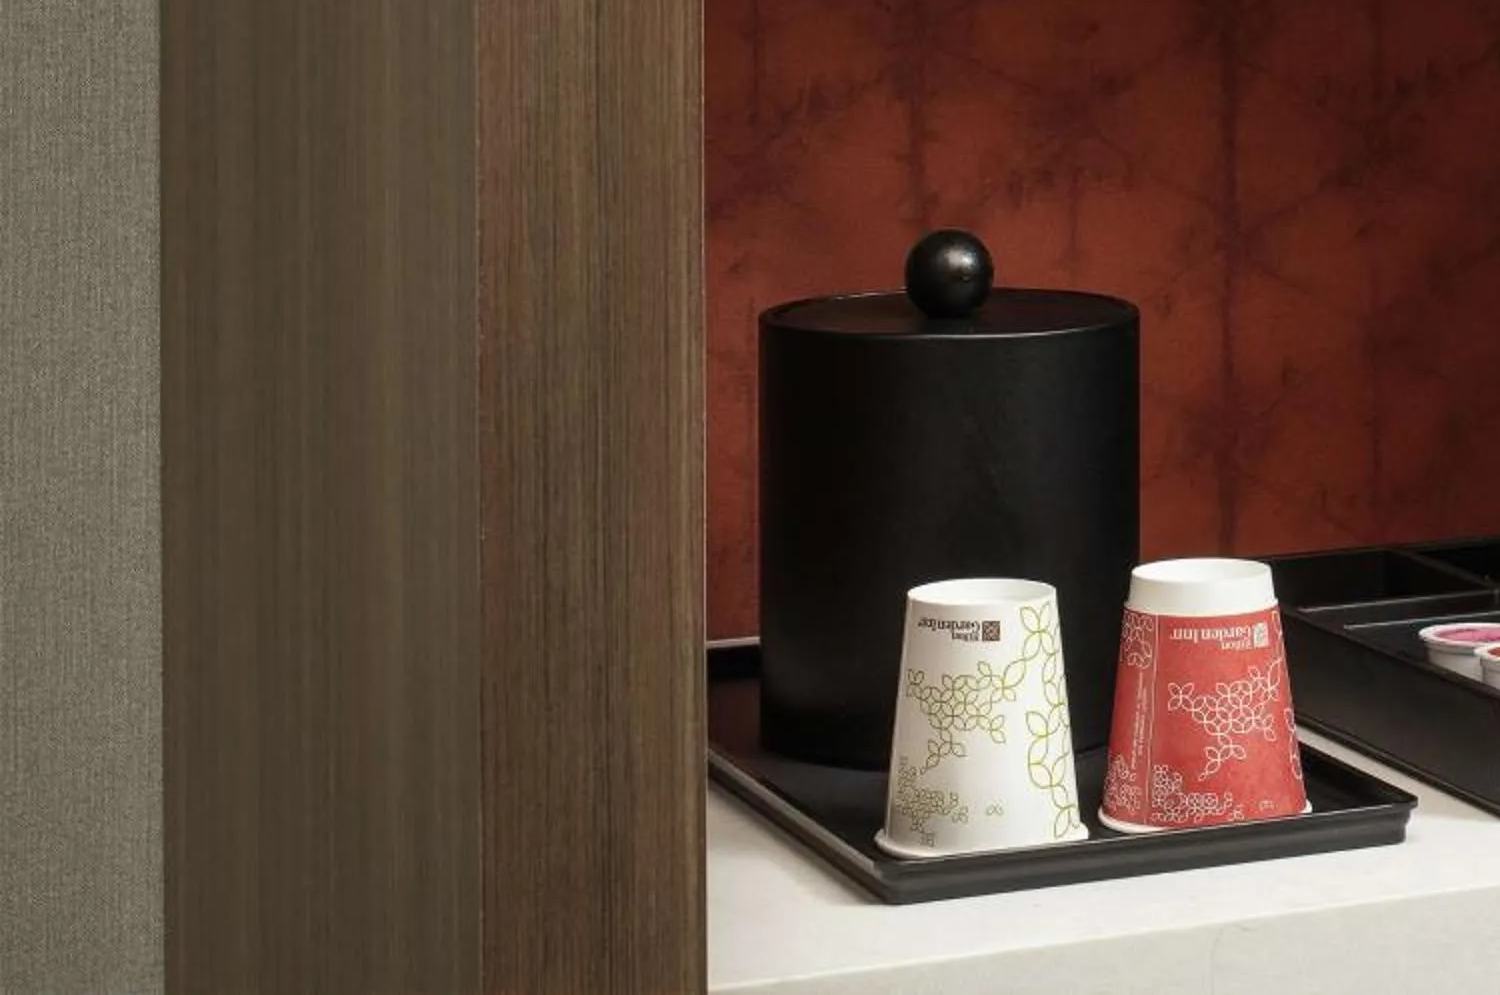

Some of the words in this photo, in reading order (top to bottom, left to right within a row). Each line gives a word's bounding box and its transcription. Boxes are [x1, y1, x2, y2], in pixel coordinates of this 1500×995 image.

[937, 620, 980, 635] Garden
[1201, 625, 1251, 642] Garden
[1172, 628, 1199, 644] Inn
